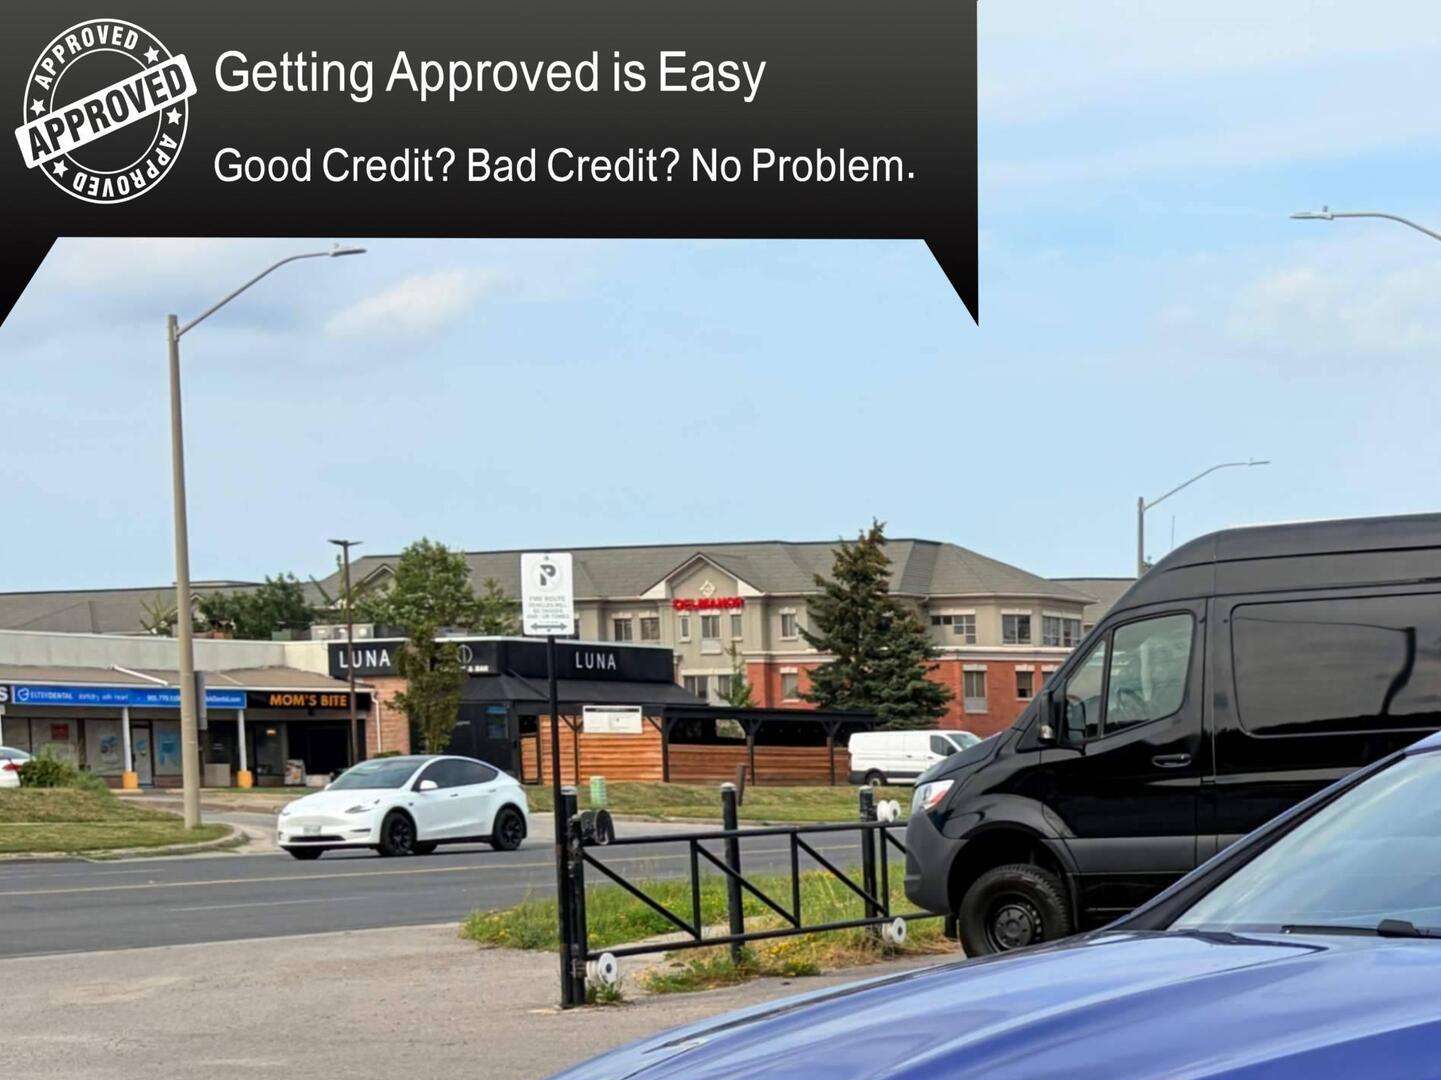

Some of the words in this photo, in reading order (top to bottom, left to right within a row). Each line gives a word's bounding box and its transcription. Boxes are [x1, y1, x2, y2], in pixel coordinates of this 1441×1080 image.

[339, 648, 391, 668] LUNA
[575, 651, 617, 670] LUNA
[269, 694, 318, 707] MOM'S
[320, 694, 348, 707] BITE
